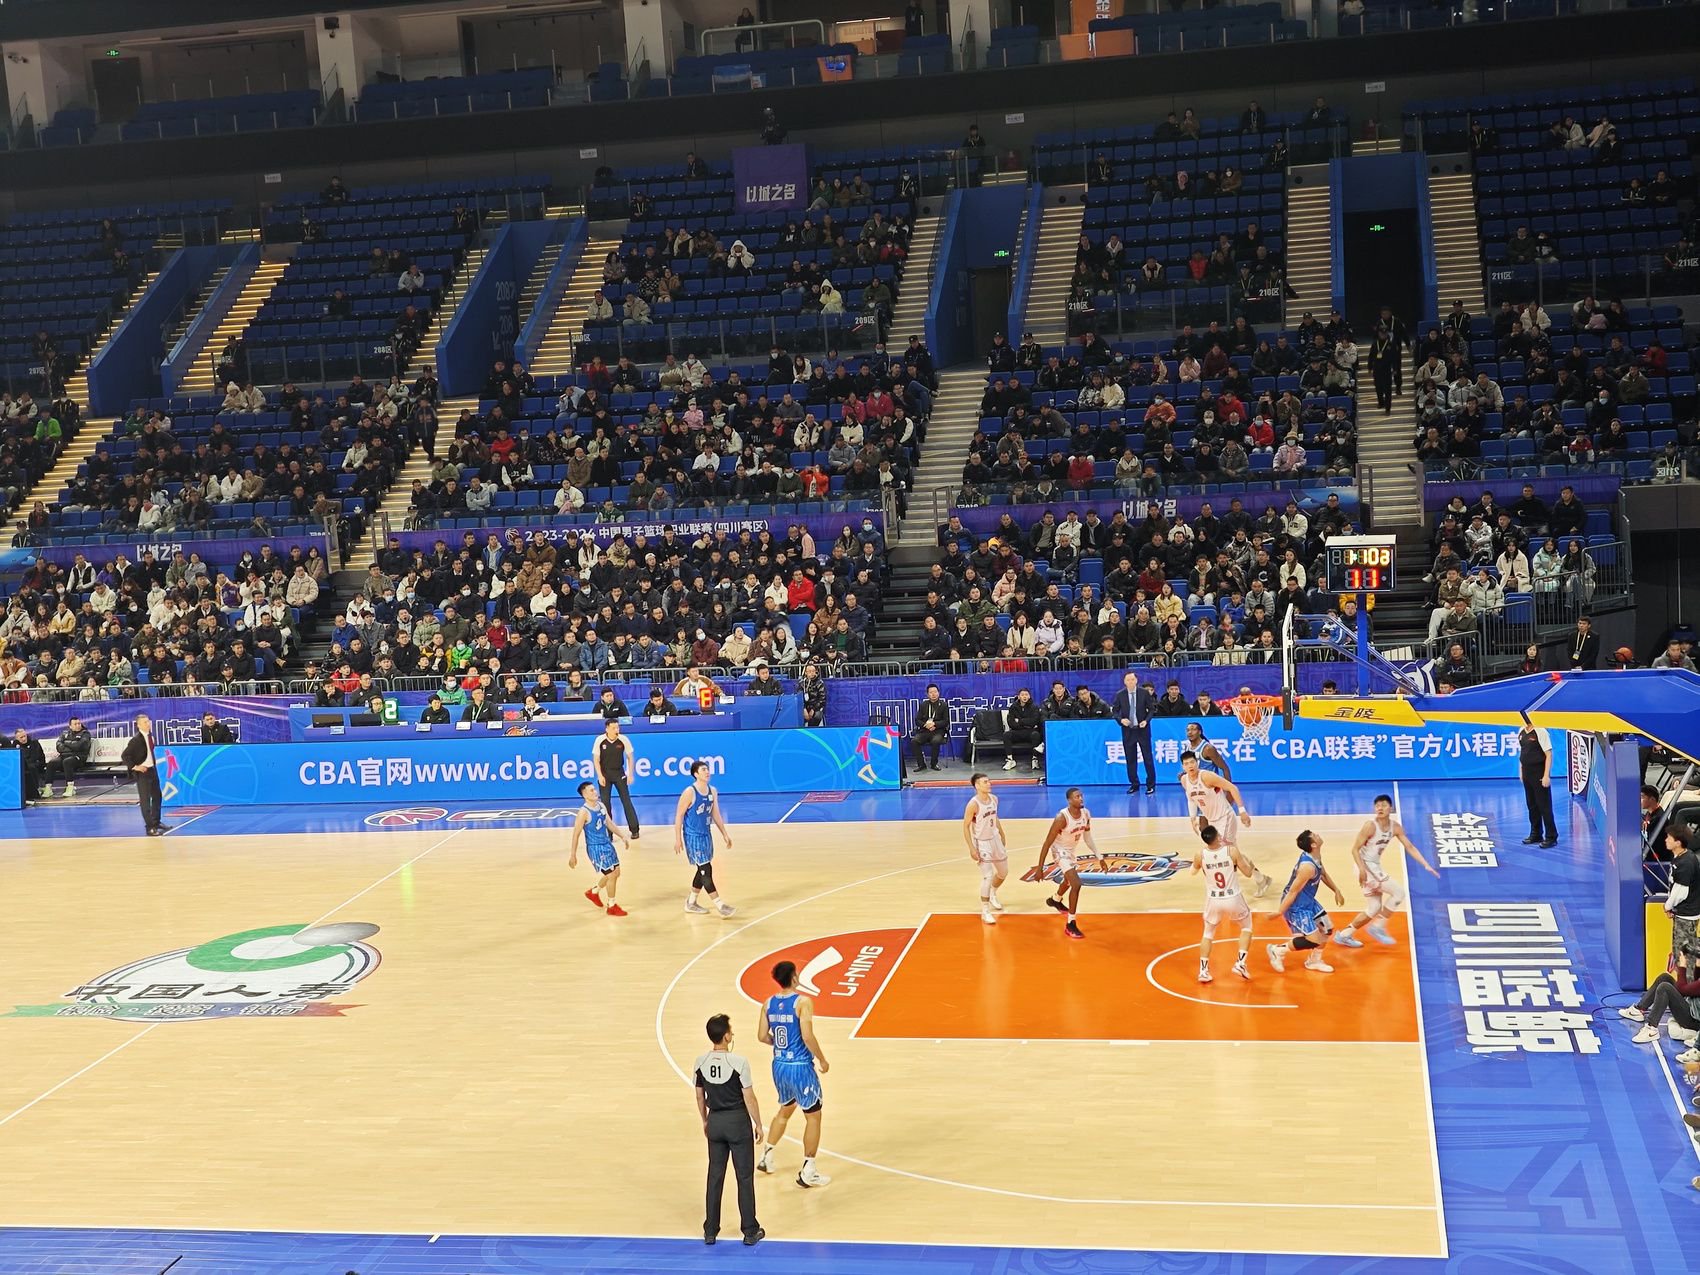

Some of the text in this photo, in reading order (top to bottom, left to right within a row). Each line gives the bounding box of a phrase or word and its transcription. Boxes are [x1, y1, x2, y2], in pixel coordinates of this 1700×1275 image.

[746, 184, 796, 202] 以城之名
[1492, 271, 1511, 280] 211区
[1122, 499, 1177, 519] 以城名
[299, 753, 725, 787] CBA官网www.cbaleae.com
[1431, 813, 1499, 868] 金强集团
[1214, 871, 1226, 889] 9
[831, 945, 884, 997] LI-NING
[1447, 903, 1602, 1054] 四川蓝鲸
[64, 983, 352, 1001] 中国人寿
[775, 1025, 788, 1049] 6
[710, 1065, 721, 1079] 81
